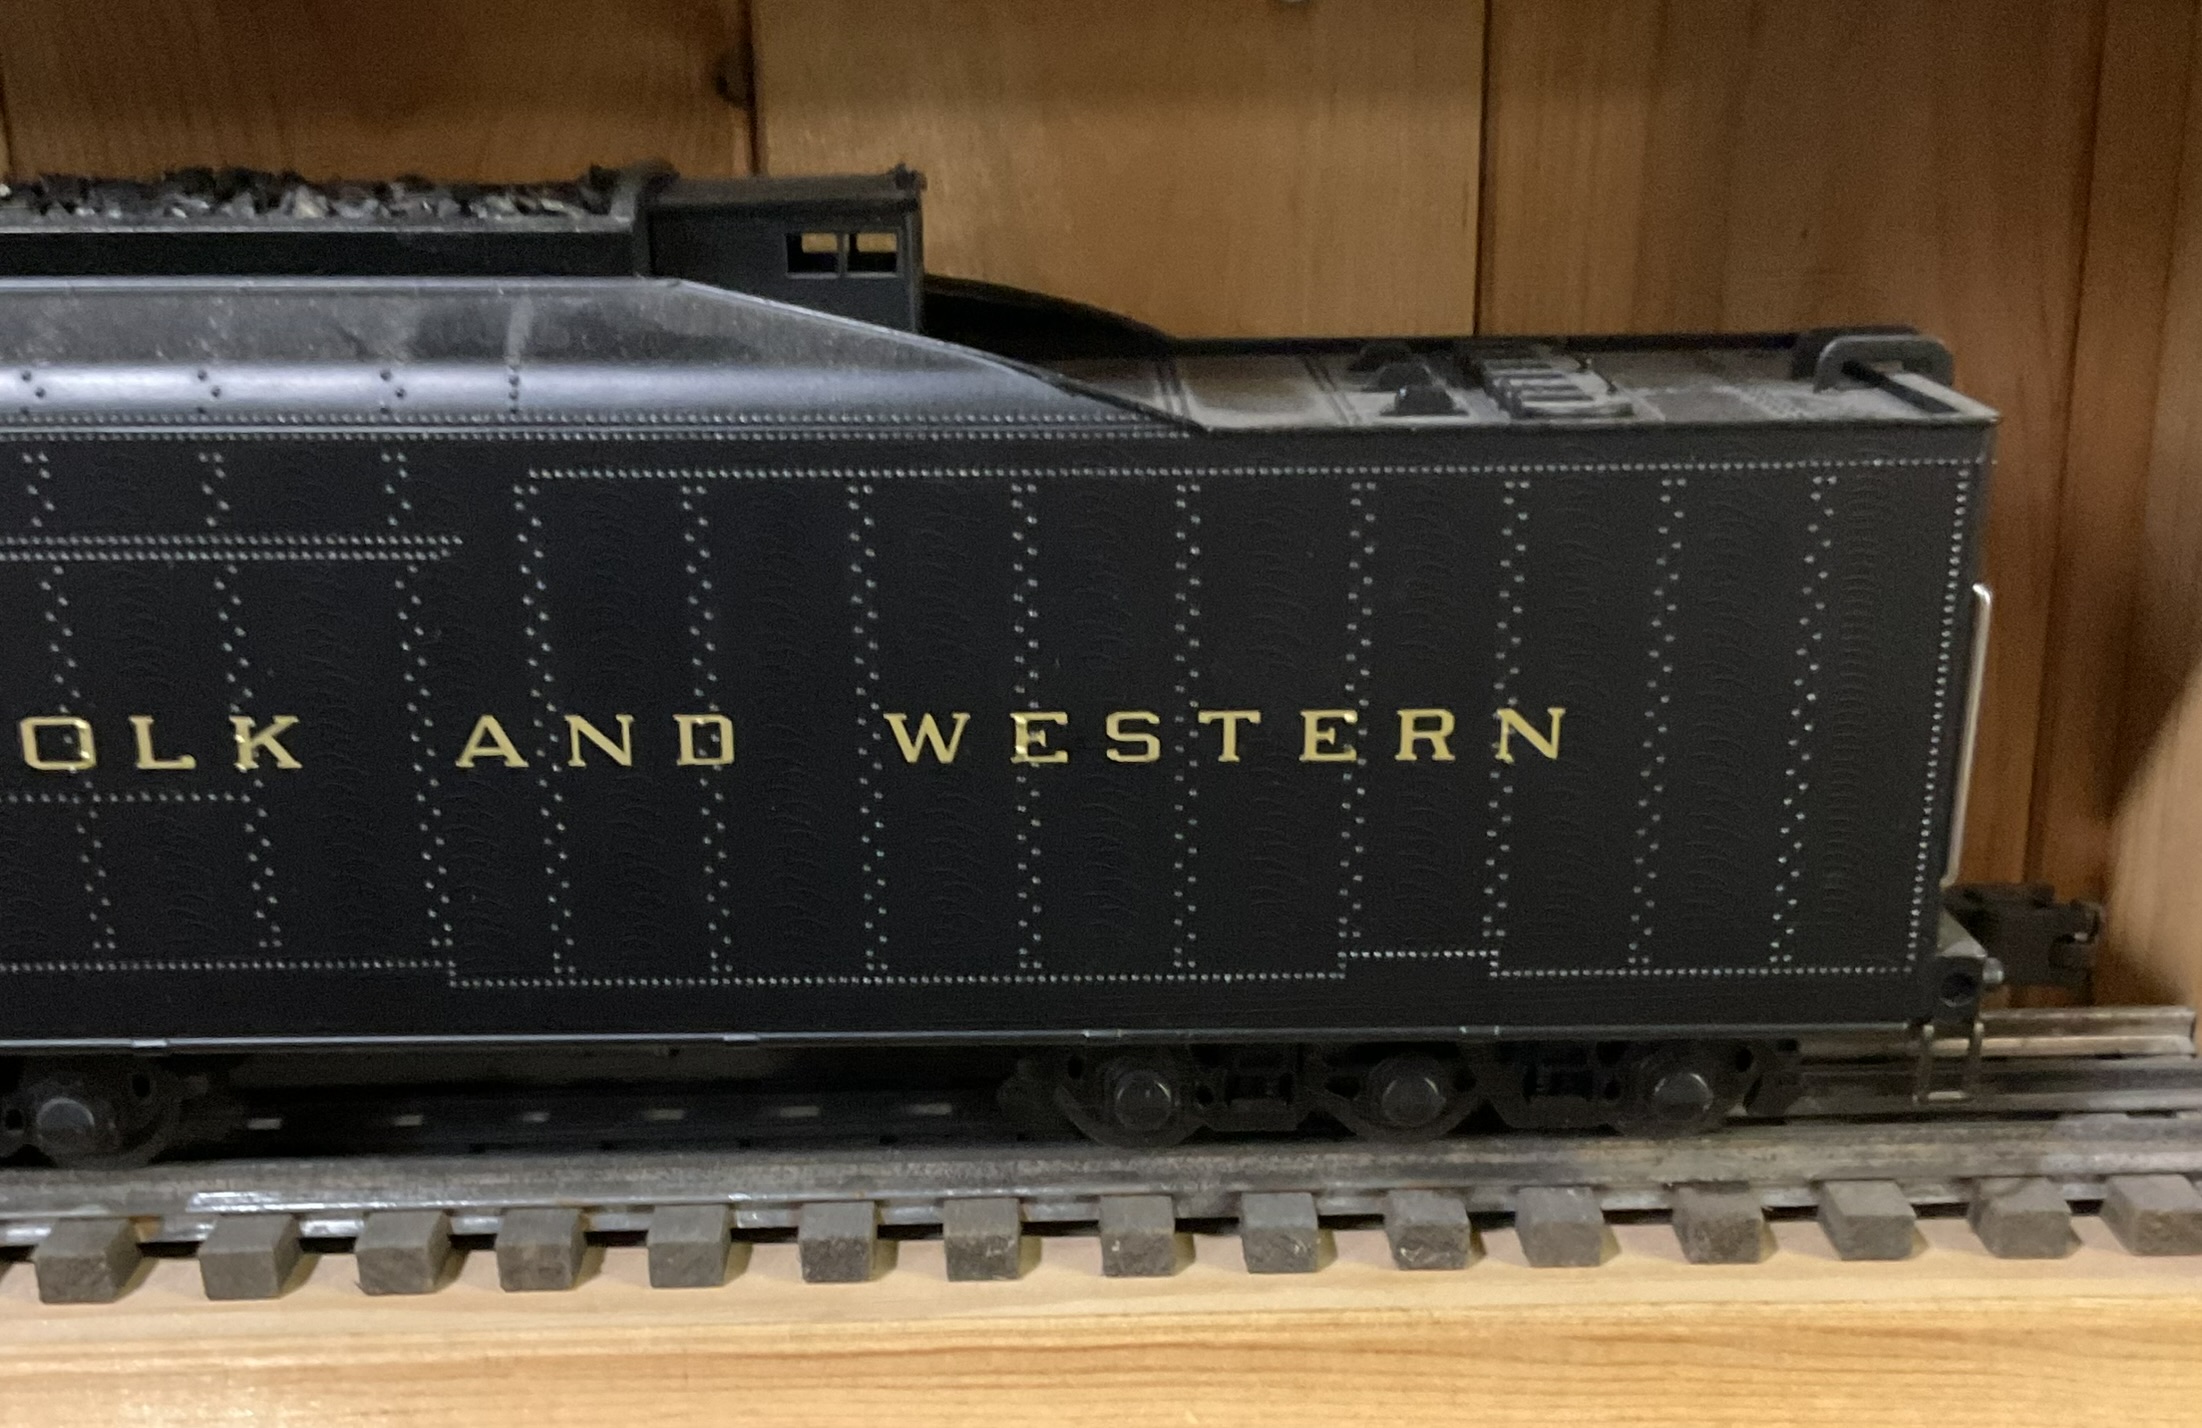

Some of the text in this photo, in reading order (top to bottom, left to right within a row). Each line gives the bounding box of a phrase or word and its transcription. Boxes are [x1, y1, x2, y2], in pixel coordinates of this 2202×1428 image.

[19, 707, 1566, 770] OLK AND WESTERN
